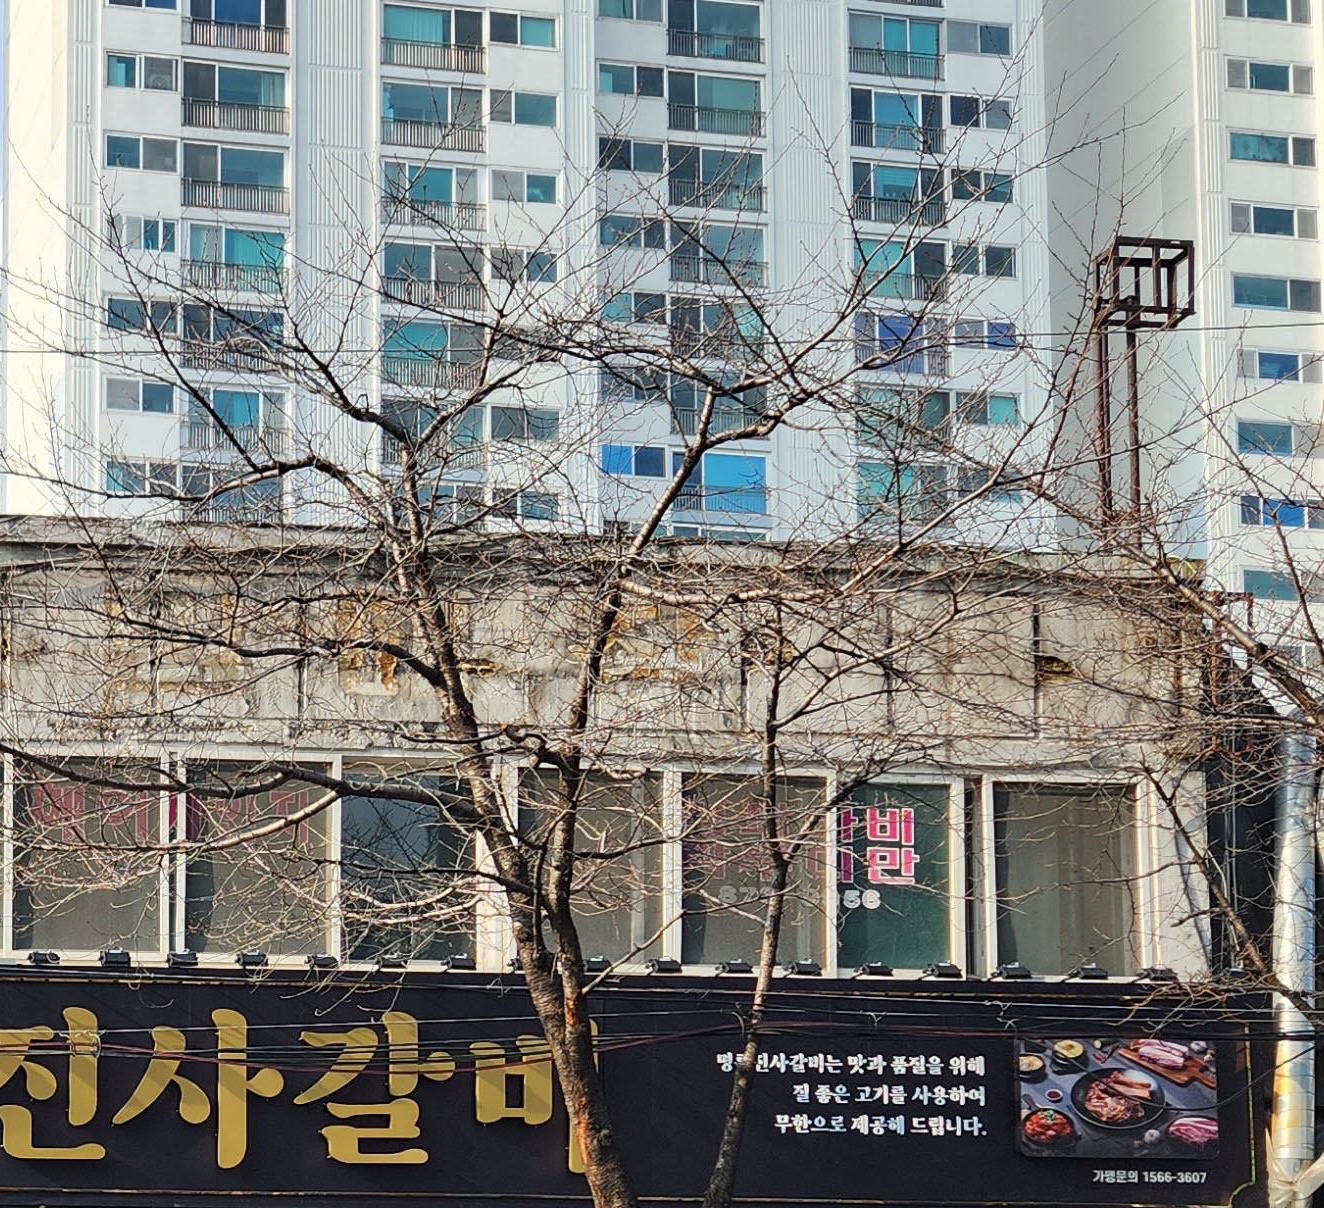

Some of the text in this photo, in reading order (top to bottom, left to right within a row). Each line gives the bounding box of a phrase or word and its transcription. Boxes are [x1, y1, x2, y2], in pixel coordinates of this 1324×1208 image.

[847, 1053, 887, 1075] 맛과
[890, 1054, 945, 1076] 품질을
[948, 1055, 986, 1076] 위해
[792, 1083, 986, 1106] 질 좋은 고기를 사용하여
[774, 1113, 988, 1137] 무한으로 제공해 드립니다.
[1092, 1170, 1207, 1184] 가맹문의 1566-3607
